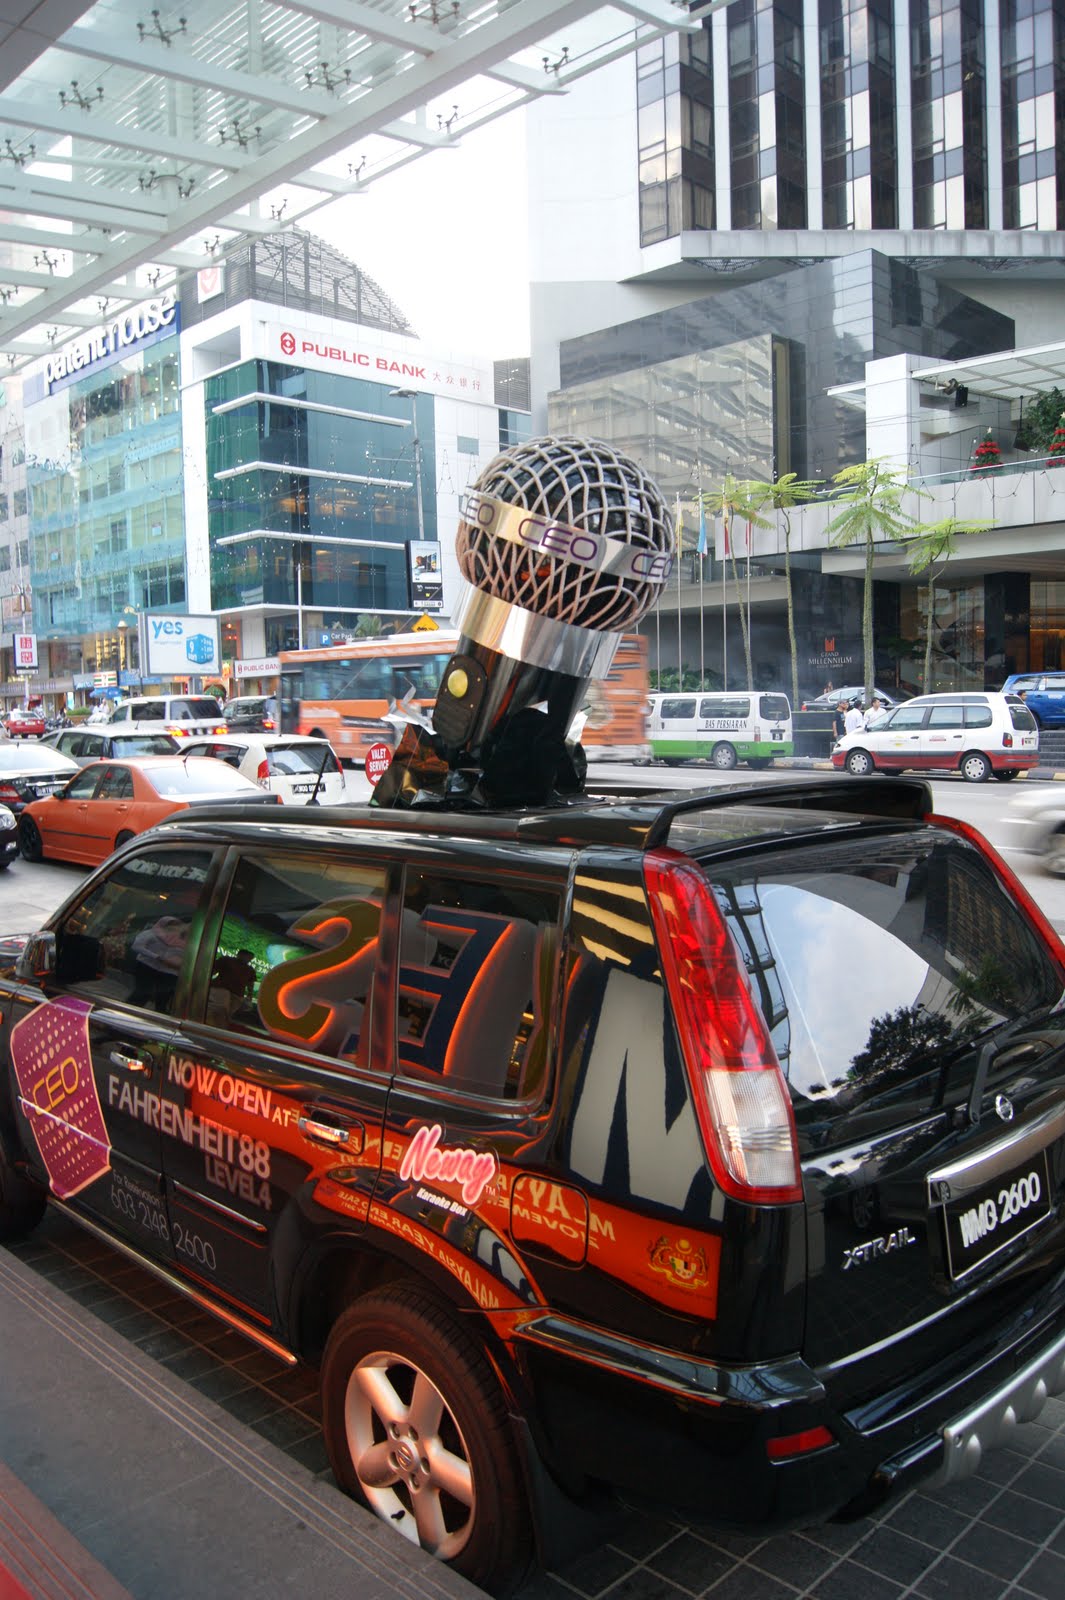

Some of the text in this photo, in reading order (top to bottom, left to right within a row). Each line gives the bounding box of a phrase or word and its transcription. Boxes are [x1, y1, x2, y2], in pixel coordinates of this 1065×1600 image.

[302, 341, 426, 379] PUBLIC BANK
[518, 517, 598, 562] CEO
[152, 620, 183, 639] yes
[243, 664, 265, 672] PUBLIC
[808, 657, 852, 665] MILLENNIUM
[705, 720, 747, 729] BAS PERSIARAN
[369, 760, 389, 773] SERVICE
[371, 748, 387, 760] VALET
[33, 1056, 79, 1115] CEO
[168, 1055, 292, 1127] NOW OPEN AT
[400, 1124, 496, 1205] Neway
[416, 1187, 468, 1217] Karaoke Box
[998, 1172, 1040, 1224] 2600
[111, 1184, 217, 1271] 603 2148 2600
